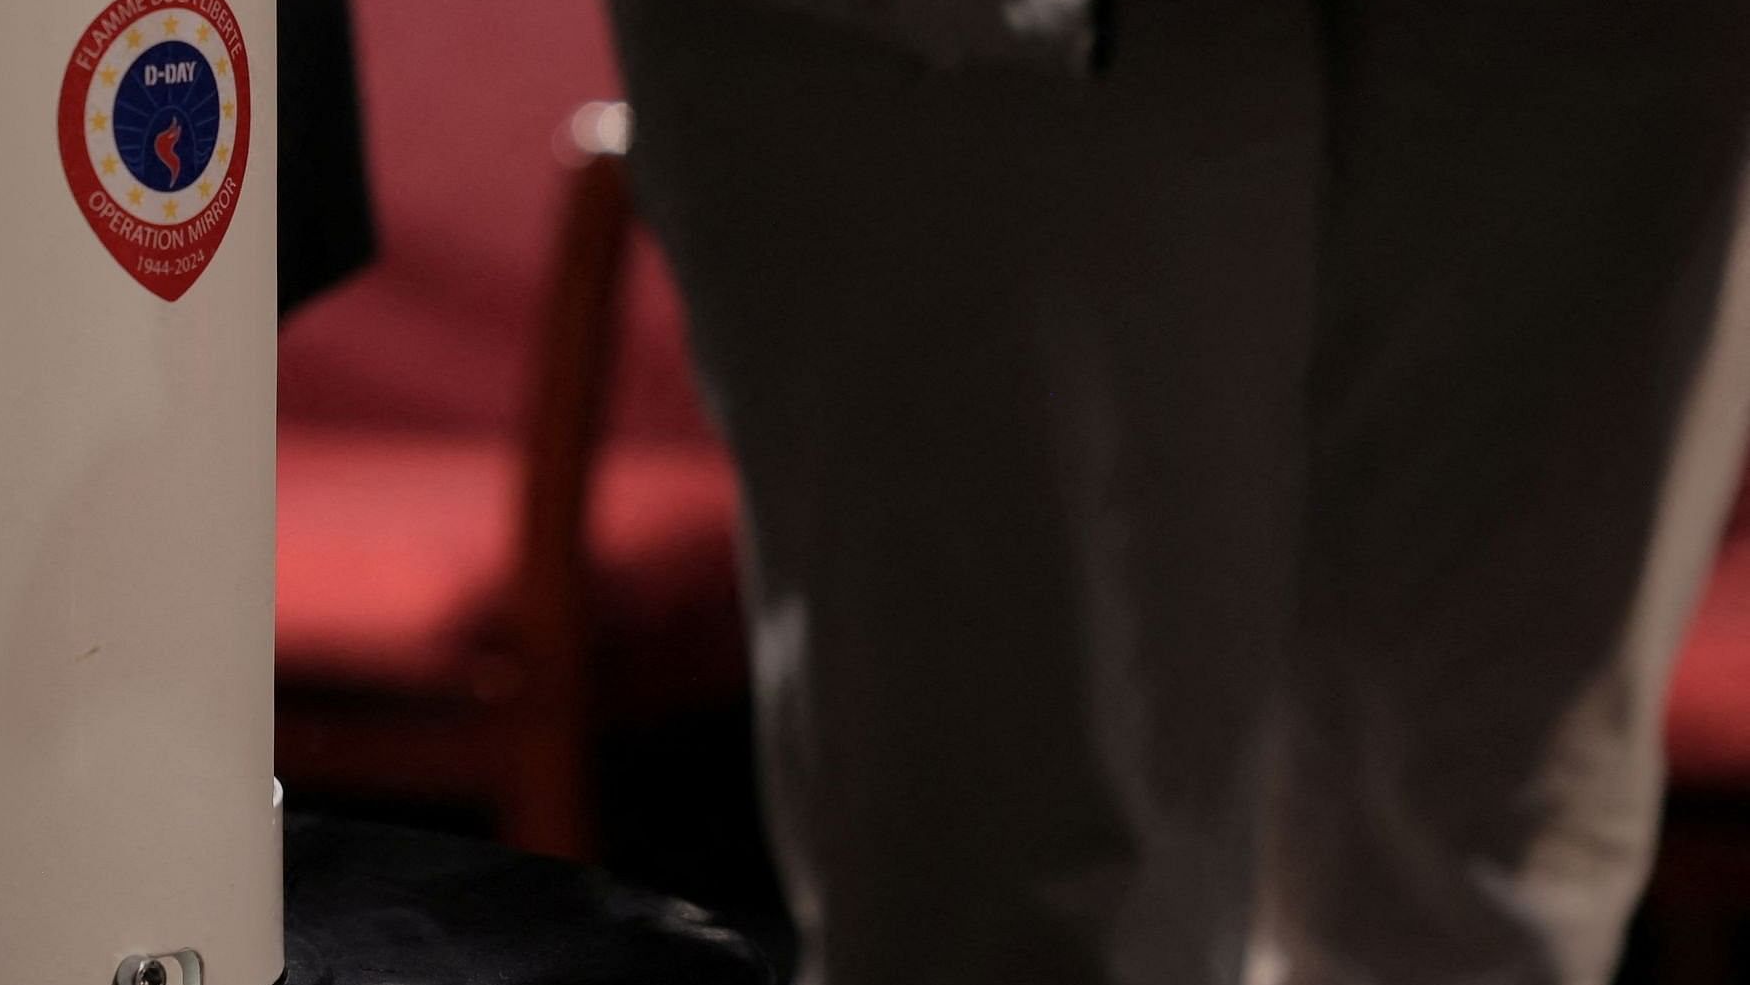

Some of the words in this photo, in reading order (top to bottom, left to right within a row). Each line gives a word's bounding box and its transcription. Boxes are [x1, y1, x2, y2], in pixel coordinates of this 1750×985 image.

[144, 61, 197, 86] D-DAY
[88, 190, 184, 250] OPERATION
[188, 176, 236, 241] MIRROR
[136, 249, 205, 275] 1944-2024
